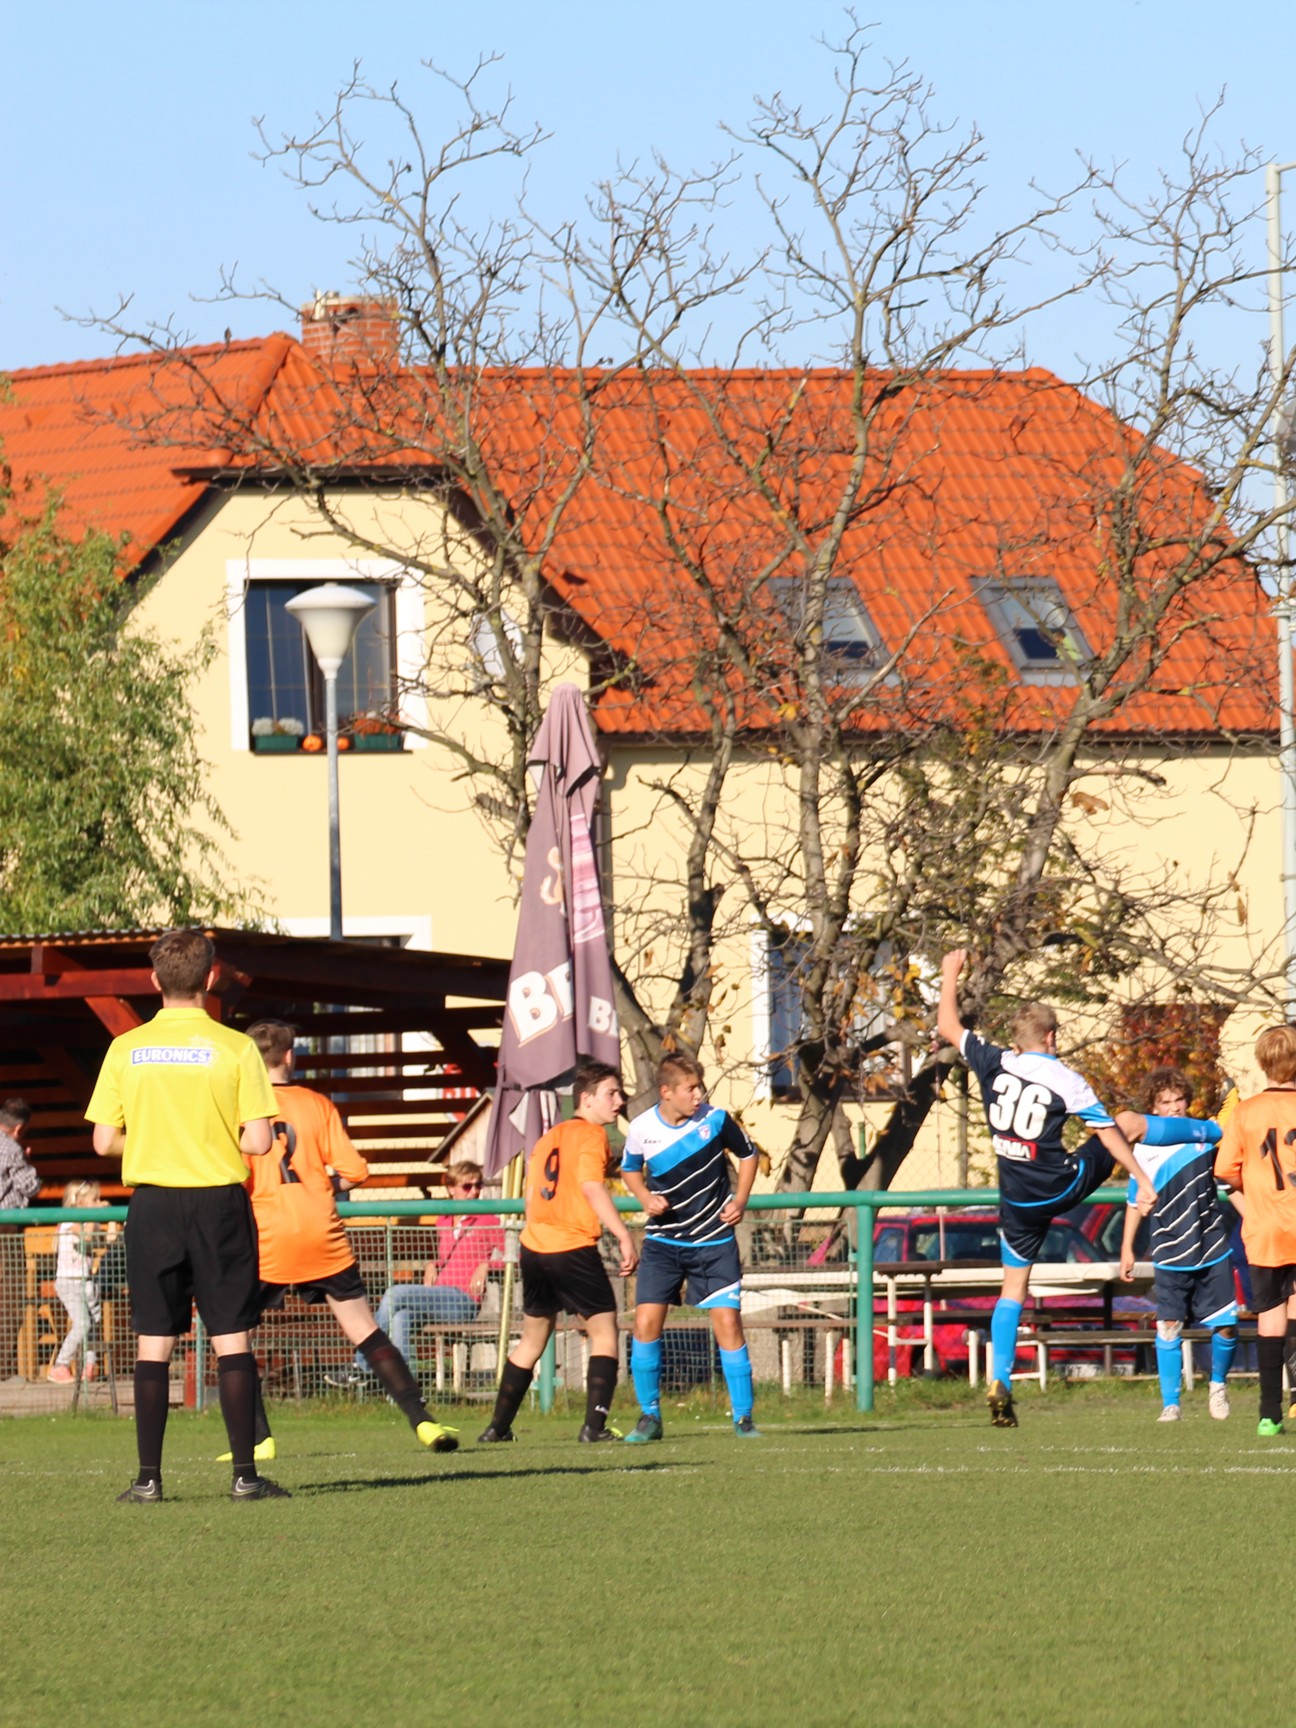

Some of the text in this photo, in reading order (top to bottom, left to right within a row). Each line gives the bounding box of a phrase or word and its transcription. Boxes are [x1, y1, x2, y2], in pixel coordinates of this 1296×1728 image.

[134, 1048, 208, 1062] EURONICS
[989, 1073, 1052, 1140] 36
[540, 1147, 559, 1200] 9
